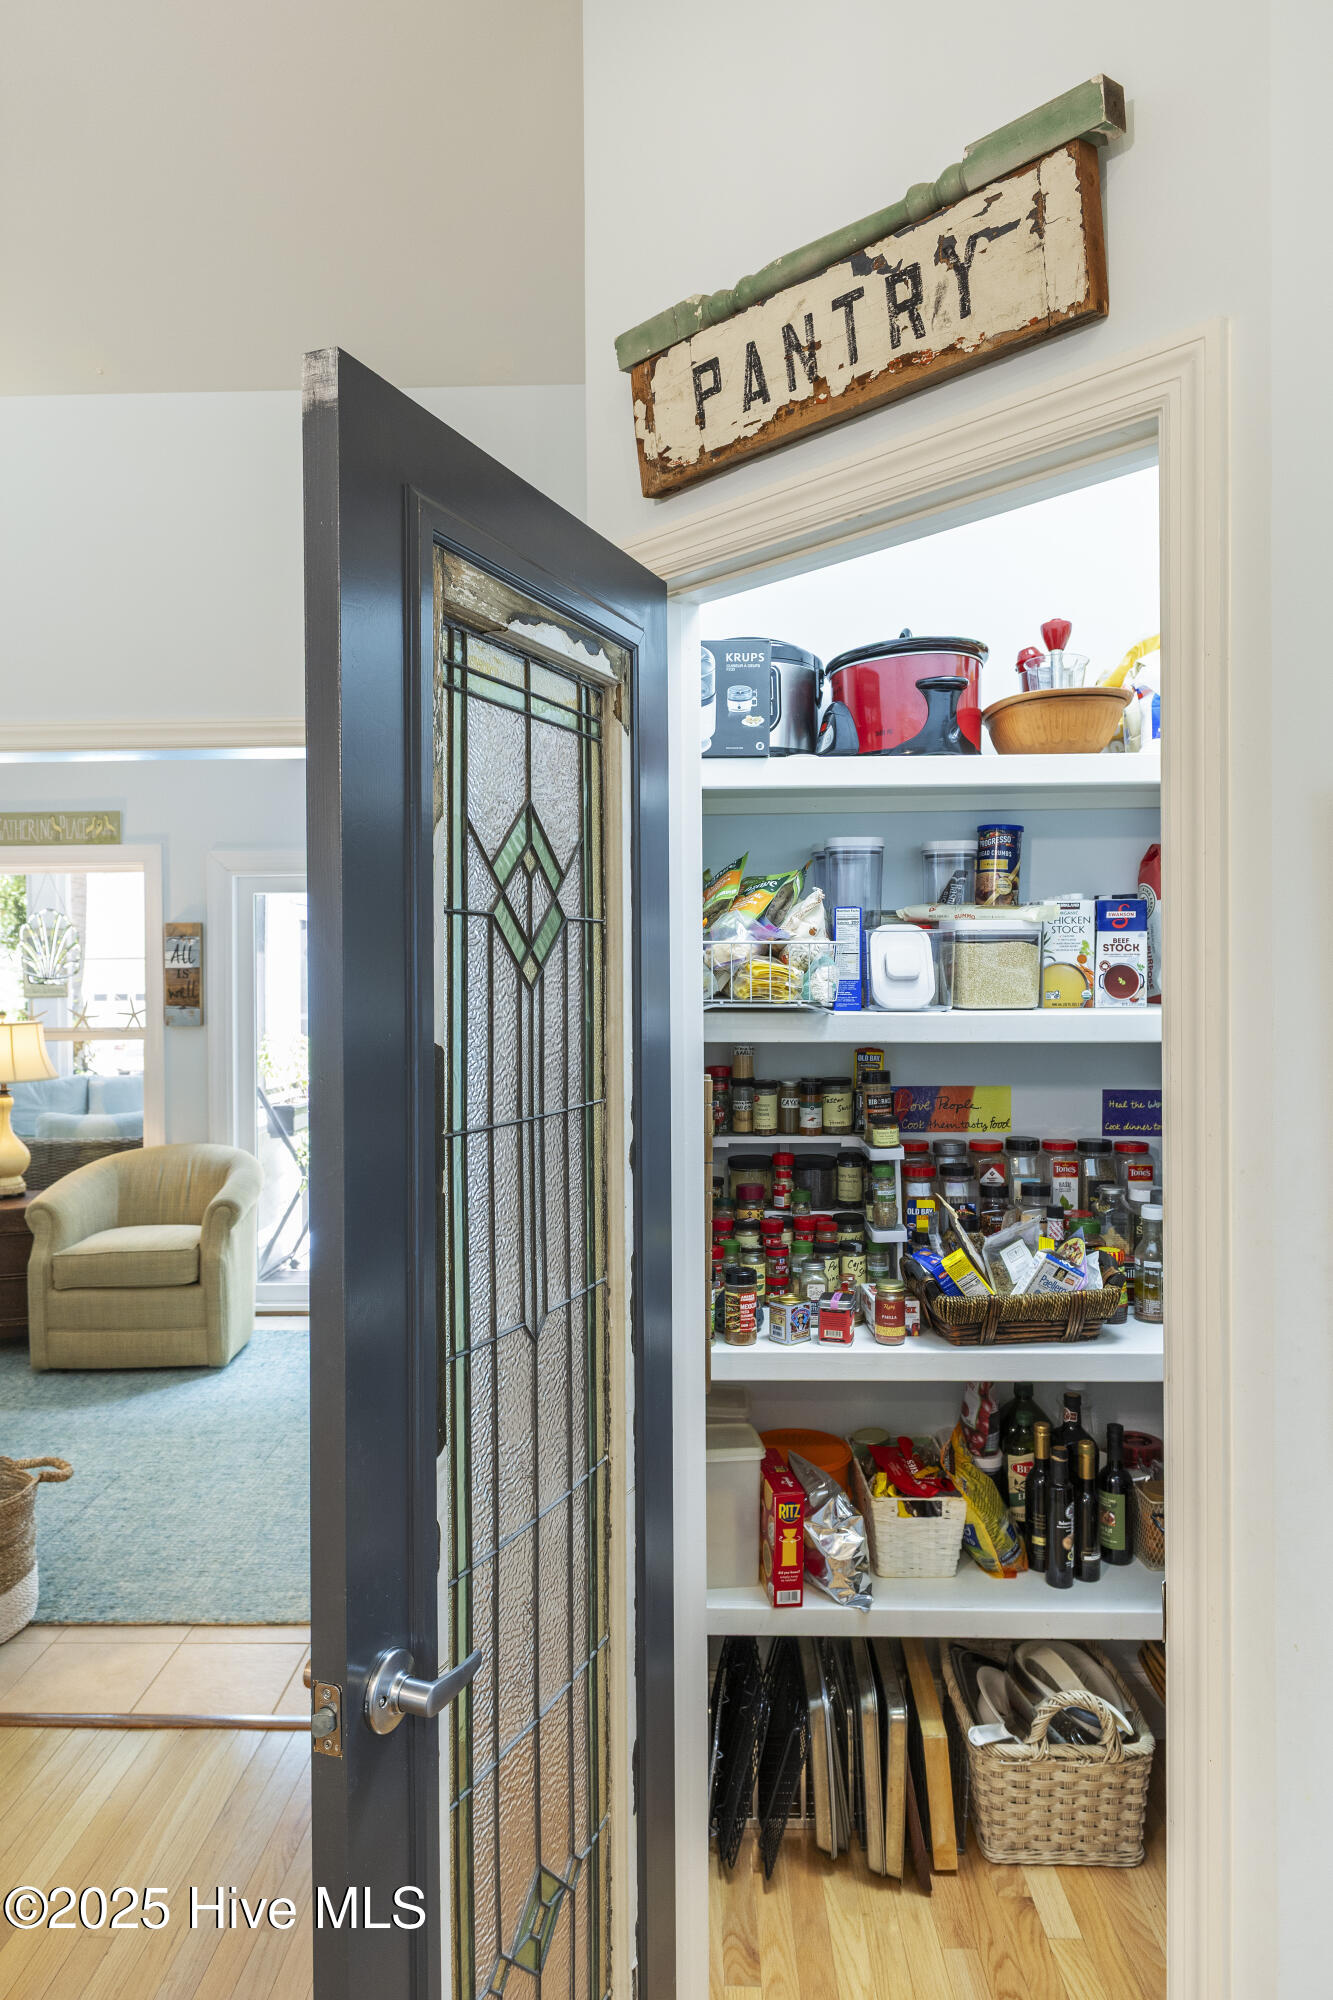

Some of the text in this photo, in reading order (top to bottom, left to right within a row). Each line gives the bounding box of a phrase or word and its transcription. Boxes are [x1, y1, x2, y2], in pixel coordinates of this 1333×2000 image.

[692, 233, 980, 431] PANTRY
[726, 652, 765, 662] KRUPS
[1051, 925, 1085, 934] STOCK
[1103, 943, 1140, 952] STOCK
[170, 943, 196, 964] All
[167, 980, 198, 999] well
[858, 1054, 881, 1062] OLD BAY
[897, 1093, 931, 1113] Love
[1108, 1099, 1128, 1109] Heal
[1130, 1099, 1146, 1109] the
[901, 1119, 925, 1130] Cook
[961, 1118, 989, 1132] tasty
[989, 1116, 1010, 1130] food
[1104, 1122, 1121, 1131] Cook
[1123, 1121, 1153, 1131] dinner
[907, 1207, 934, 1215] OLD BAY
[779, 1503, 801, 1520] RITZ
